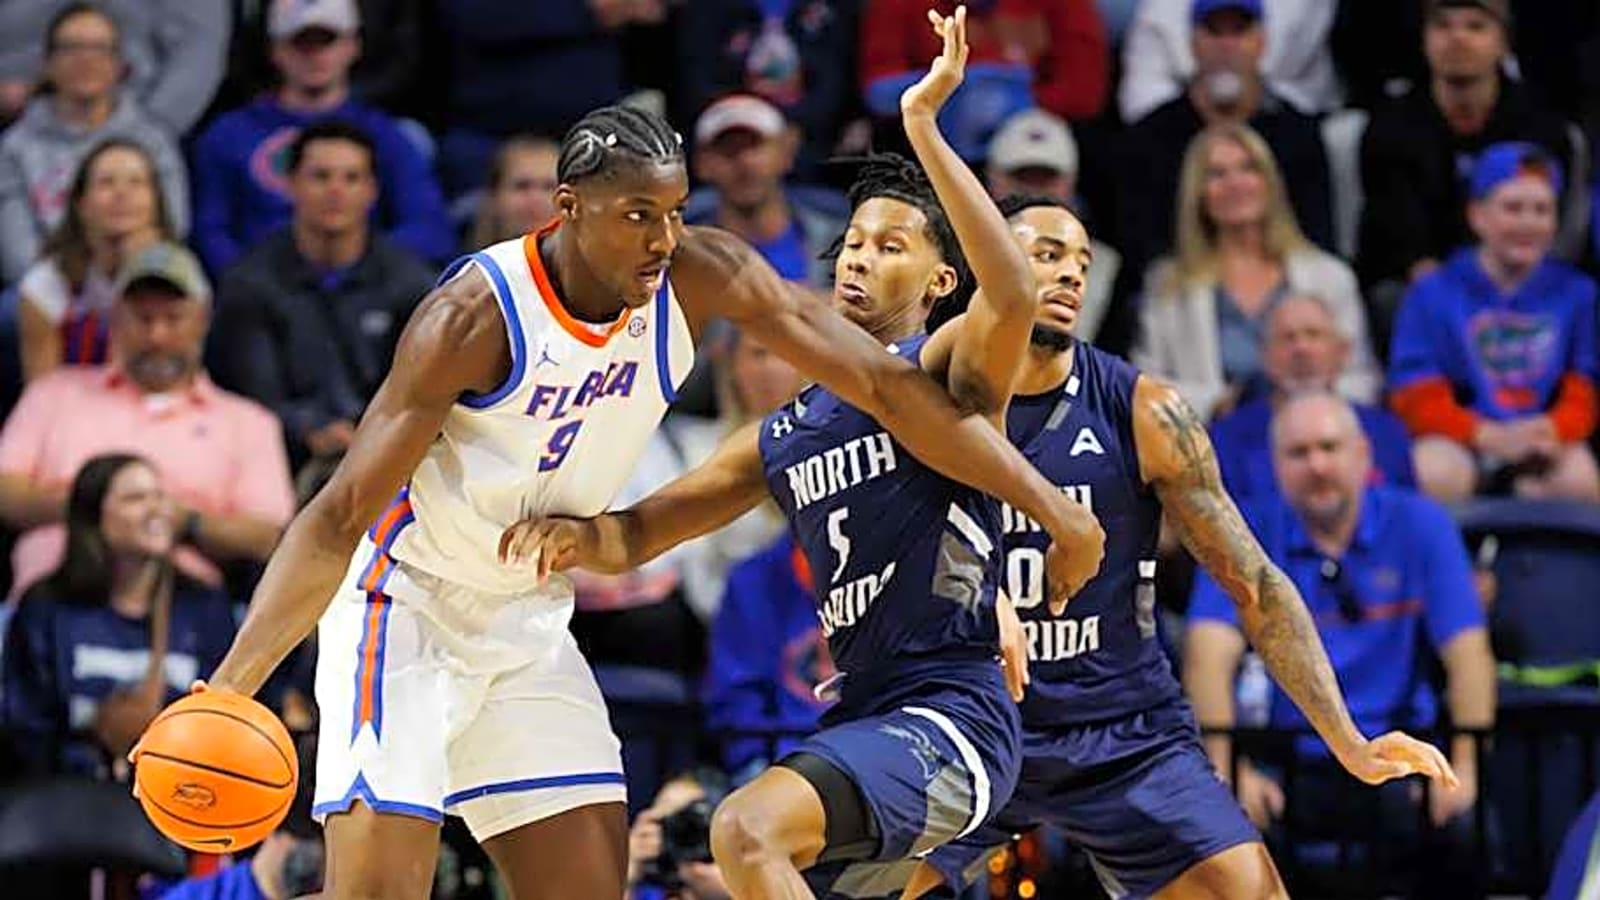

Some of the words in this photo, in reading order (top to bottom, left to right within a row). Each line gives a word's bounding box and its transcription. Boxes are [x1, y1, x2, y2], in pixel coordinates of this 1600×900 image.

[537, 419, 583, 473] 9
[785, 432, 897, 510] NORTH
[826, 507, 850, 584] 5
[1006, 547, 1044, 609] 0
[1019, 615, 1100, 662] RIDA
